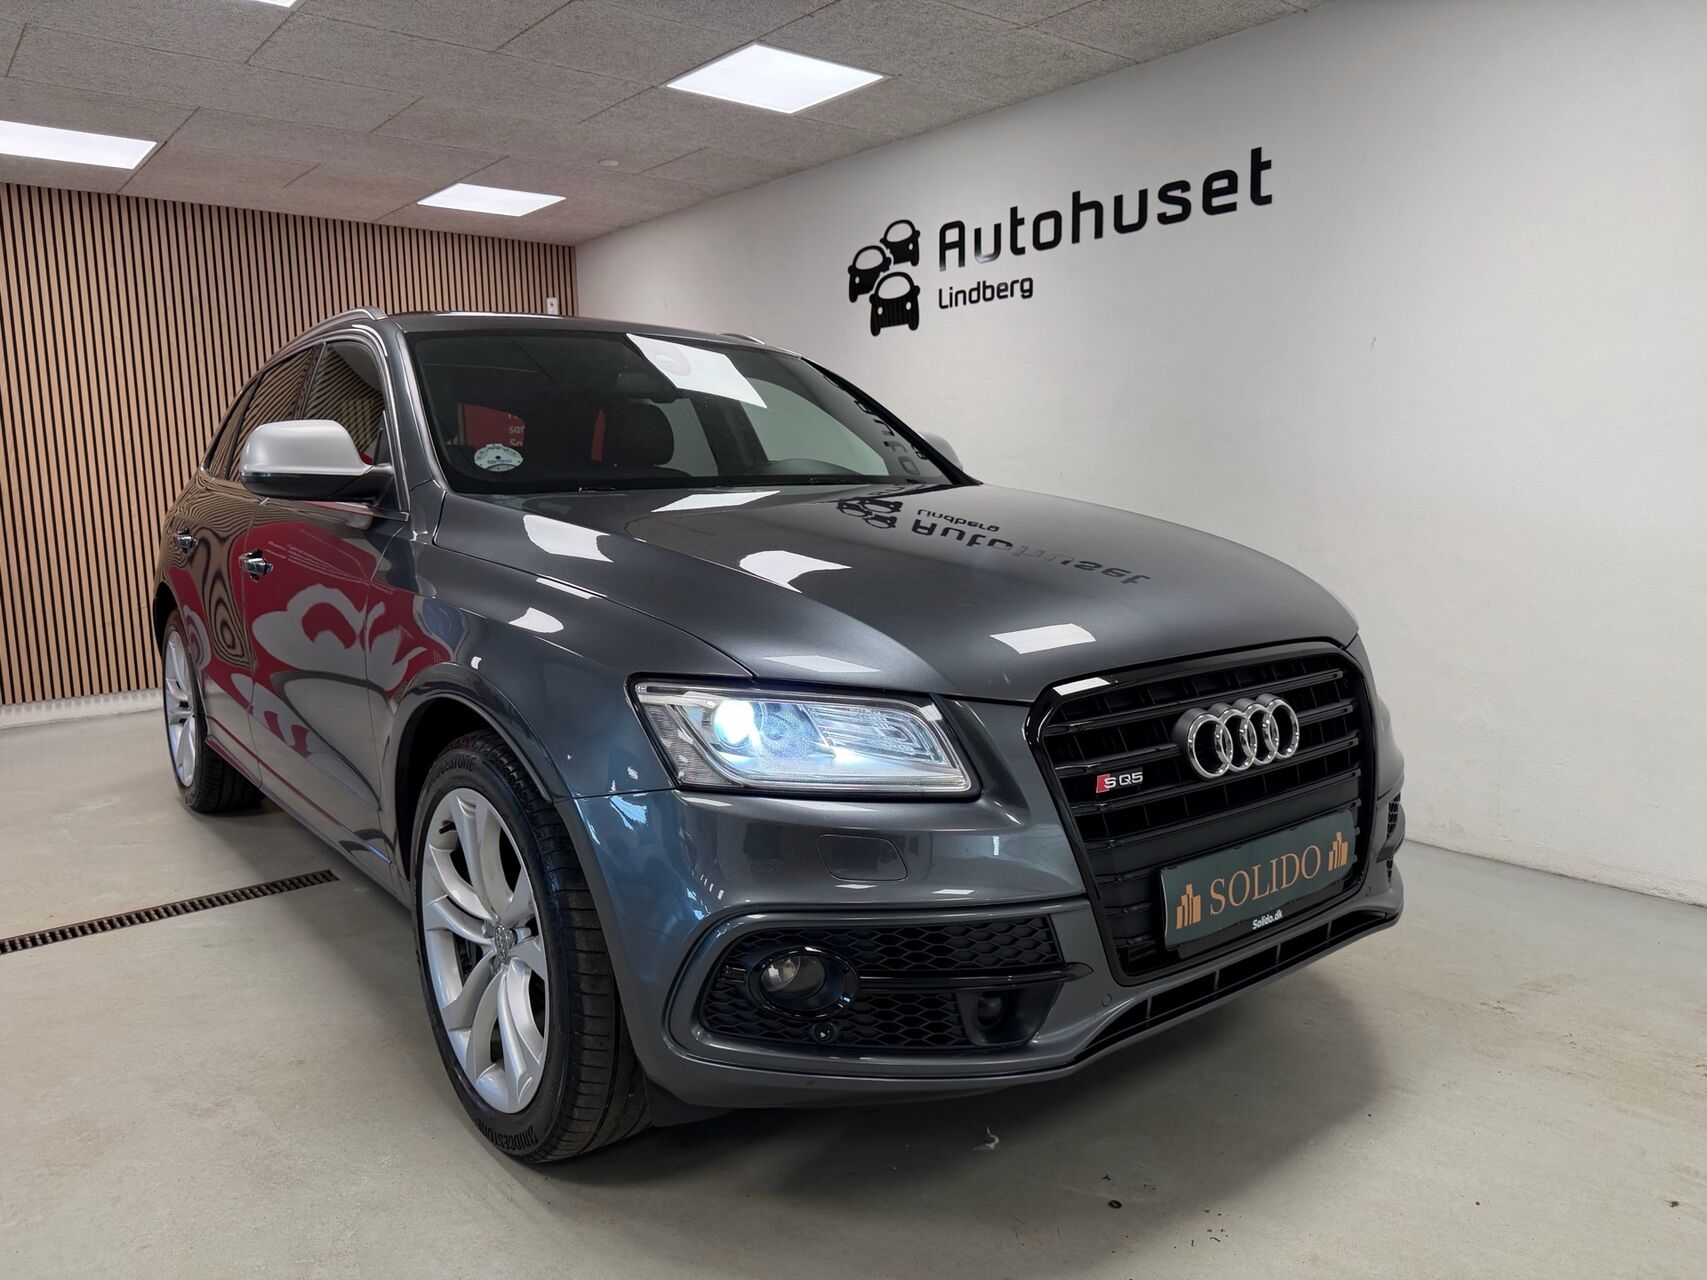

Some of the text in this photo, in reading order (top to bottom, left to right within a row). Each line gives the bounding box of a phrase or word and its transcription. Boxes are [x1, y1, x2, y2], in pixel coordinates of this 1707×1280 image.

[938, 146, 1273, 272] Autohuset
[938, 276, 1034, 310] Lindberg
[1208, 844, 1322, 917] SOLIDO
[1252, 908, 1284, 930] Solido.dk
